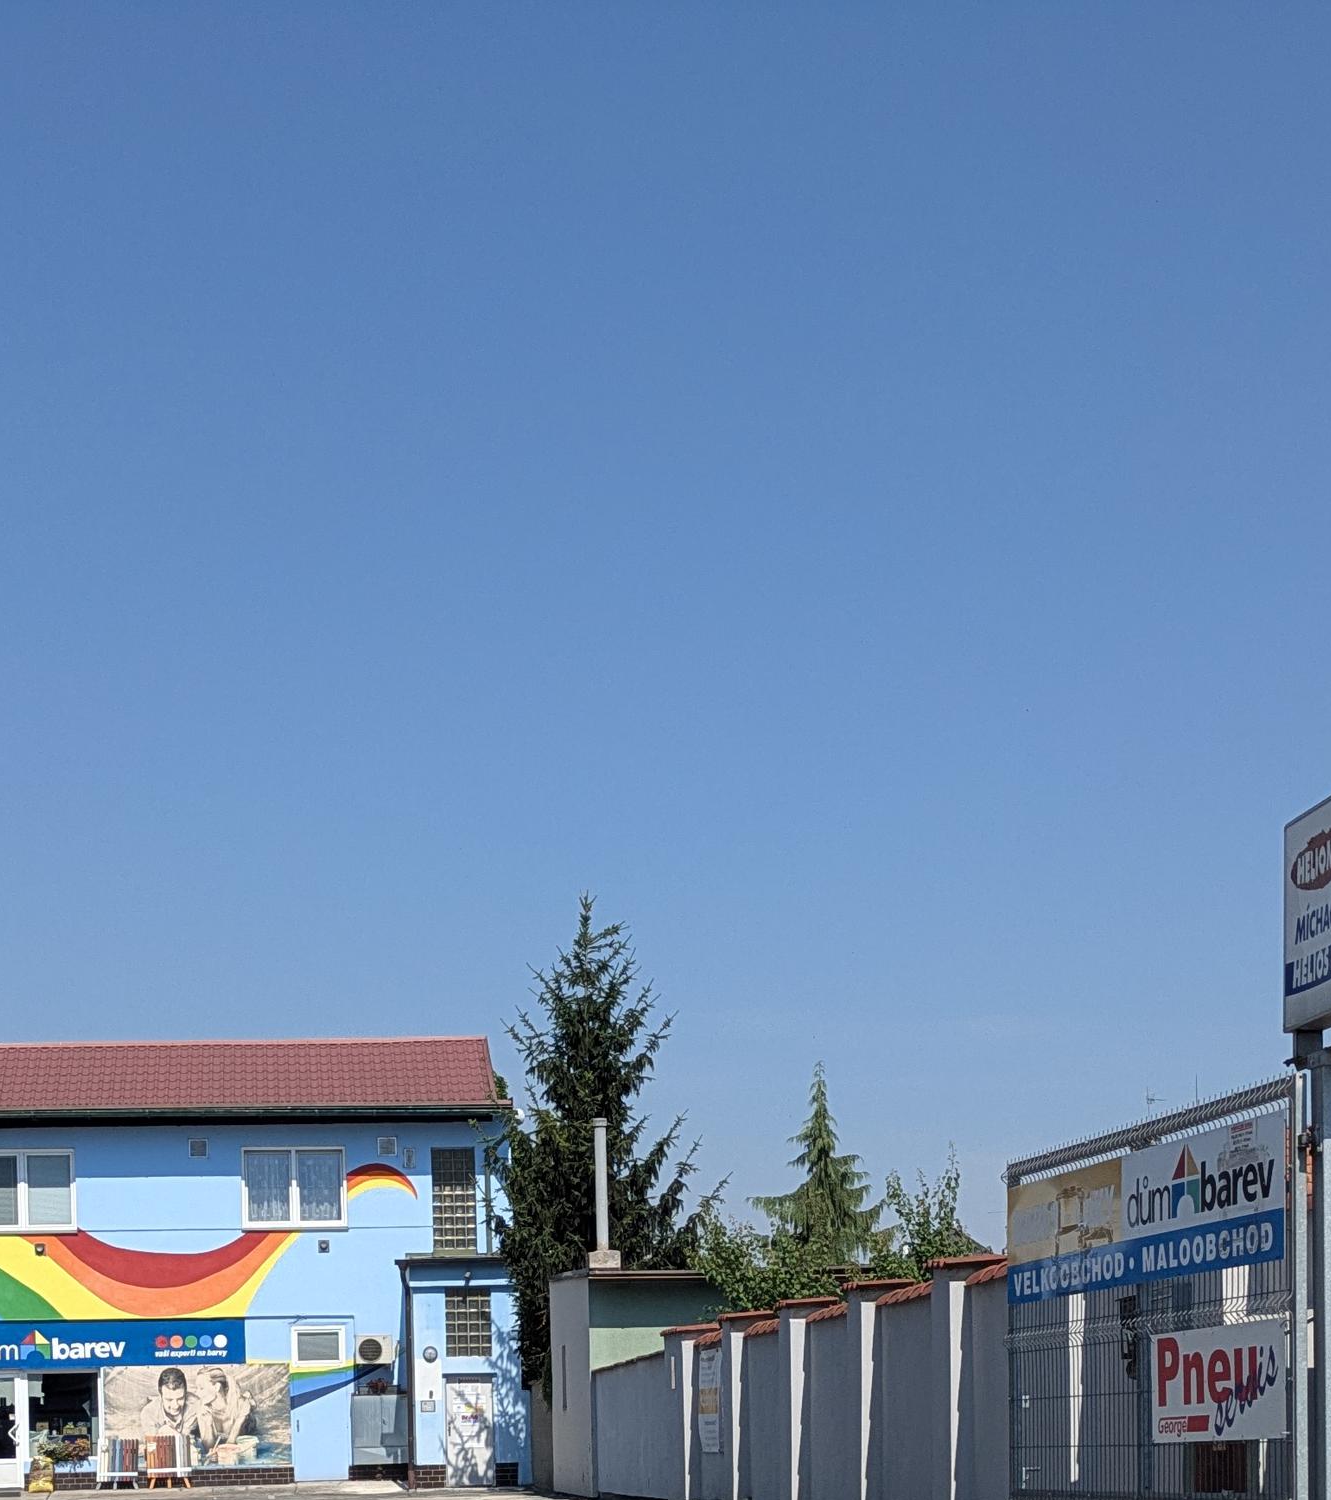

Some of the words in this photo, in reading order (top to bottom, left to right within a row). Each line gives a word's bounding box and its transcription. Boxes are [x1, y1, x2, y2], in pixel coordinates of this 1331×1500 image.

[1292, 946, 1330, 989] HELIOS
[1127, 1175, 1172, 1229] dům
[1200, 1158, 1275, 1213] barev
[1013, 1252, 1125, 1297] VELKOOBCHOD
[1141, 1222, 1274, 1273] MALOOBCHOD
[51, 1337, 126, 1360] barev
[1157, 1337, 1258, 1408] Pneu
[1158, 1416, 1187, 1438] George
